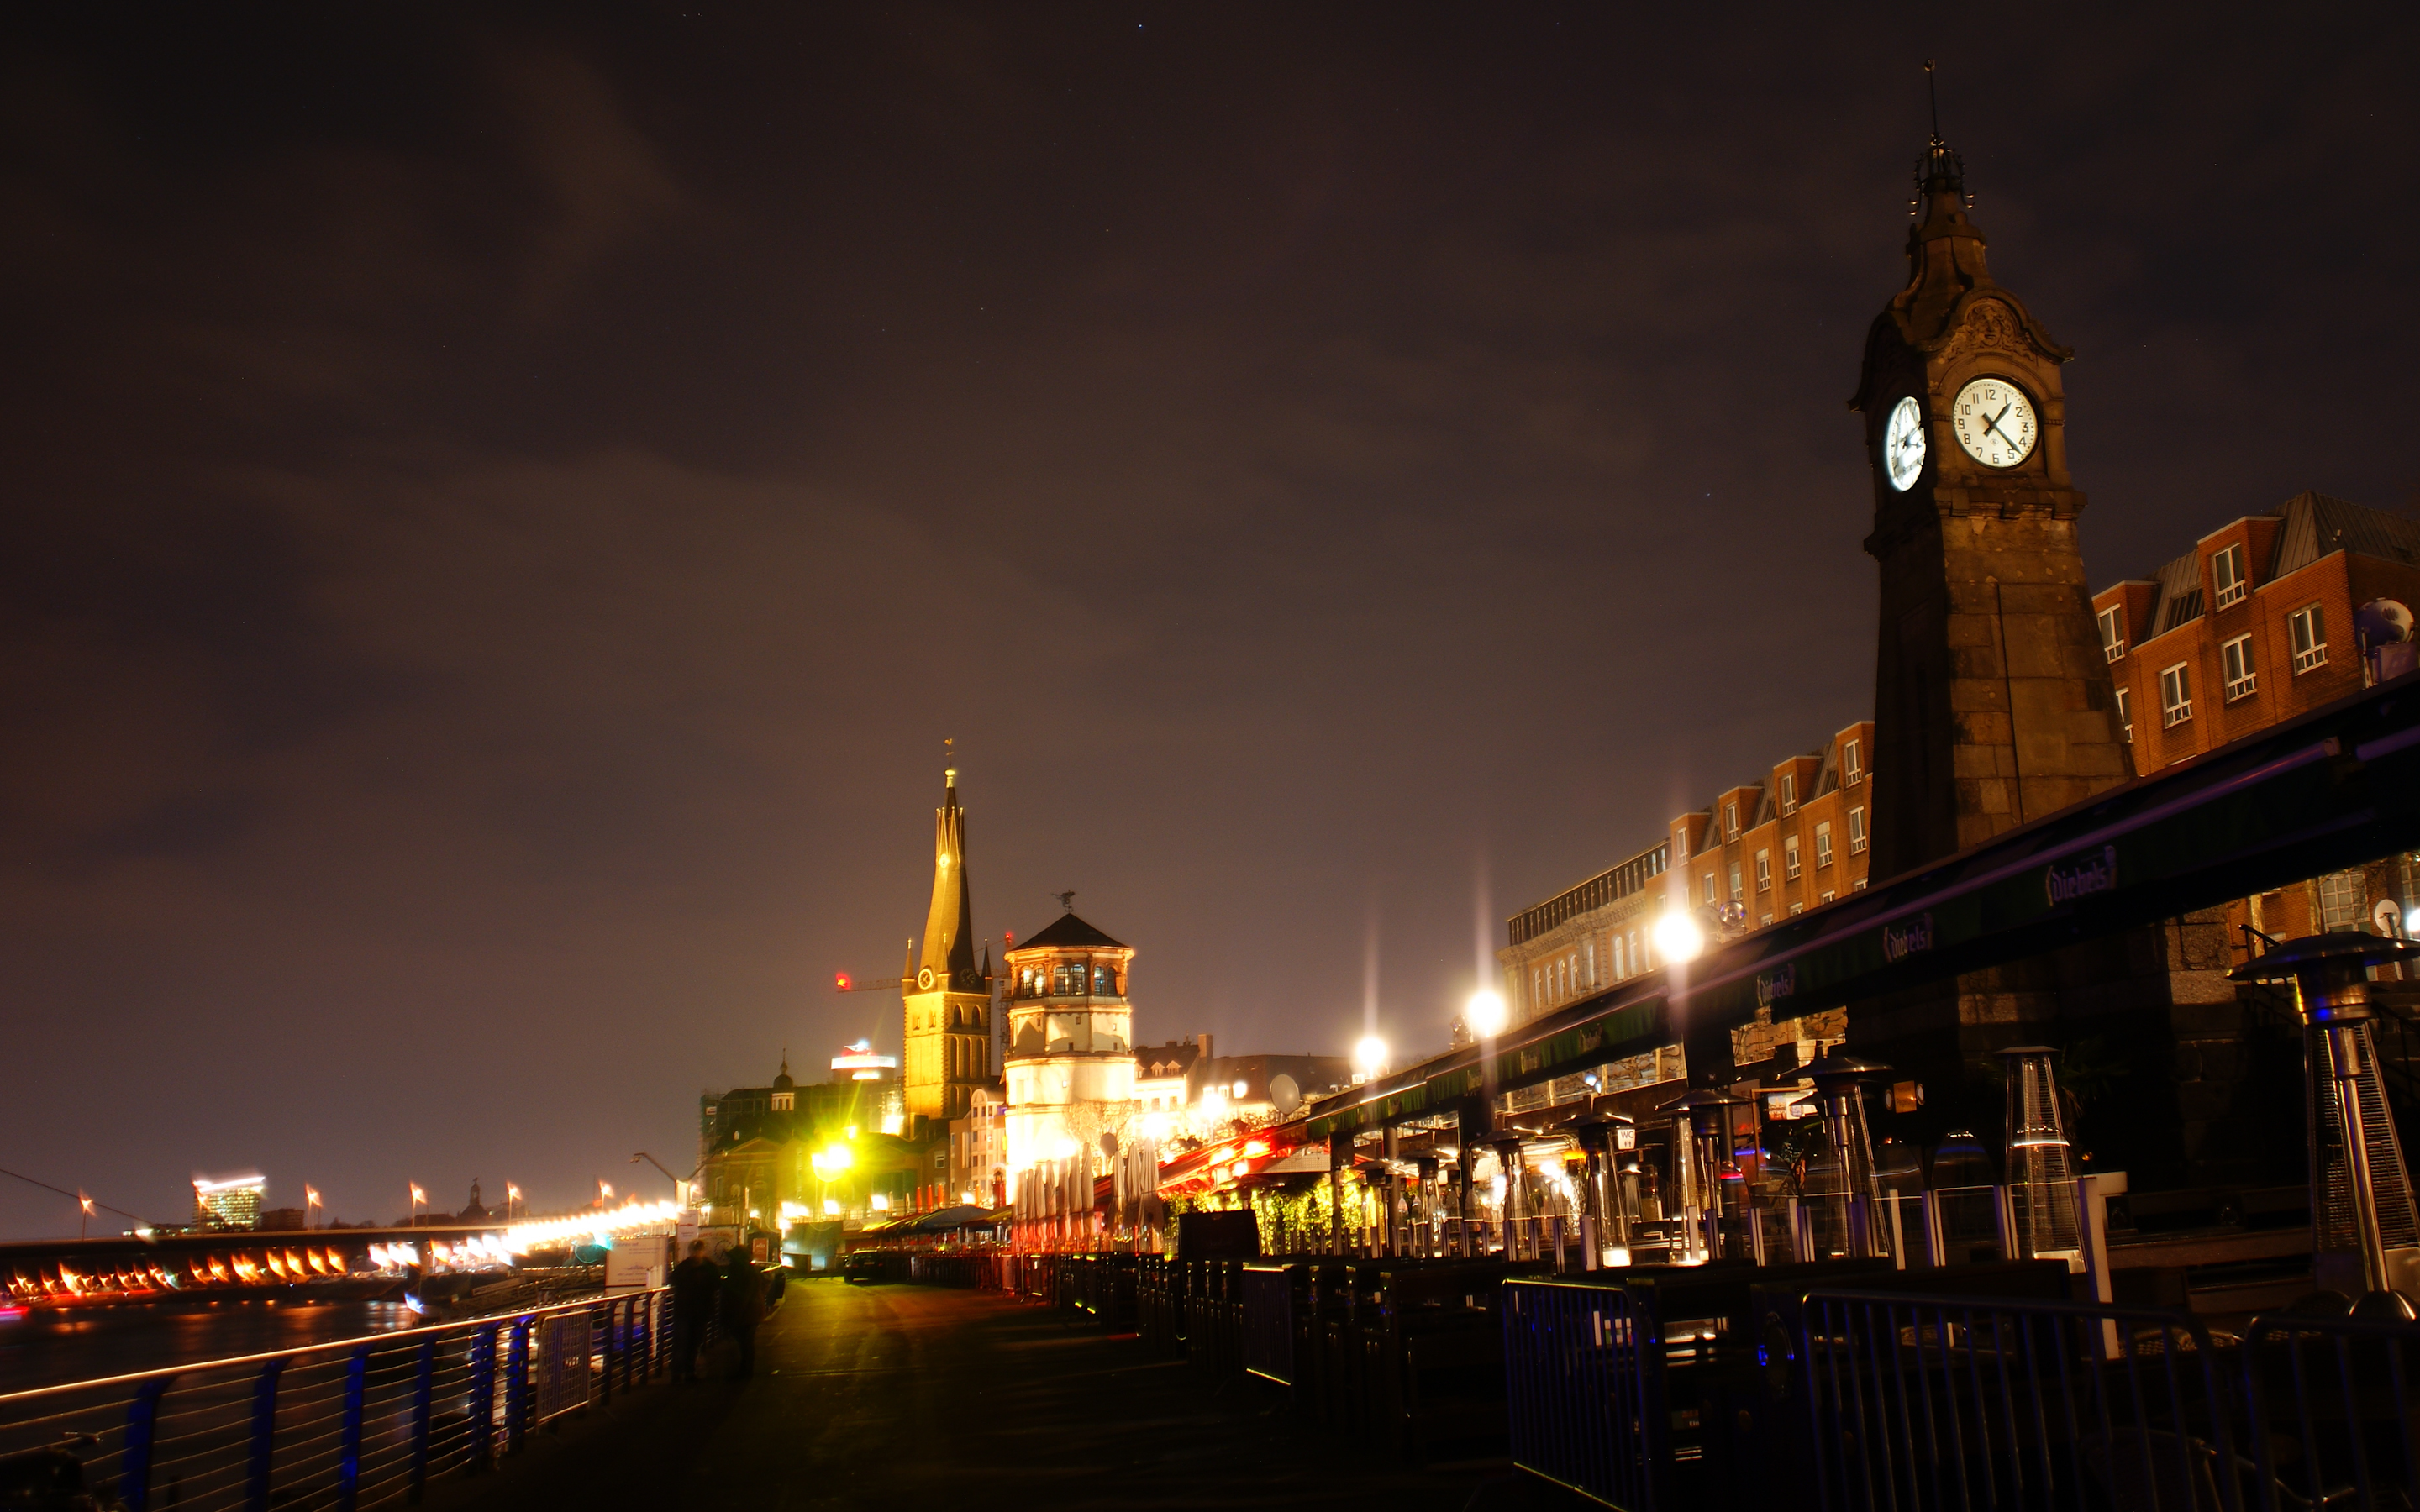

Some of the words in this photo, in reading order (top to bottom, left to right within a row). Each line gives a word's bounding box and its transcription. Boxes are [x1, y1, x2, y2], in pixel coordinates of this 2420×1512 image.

[1973, 394, 1979, 404] 11
[1986, 389, 1996, 400] 12
[1961, 404, 1971, 415] 10
[2016, 407, 2023, 417] 2
[1958, 418, 1965, 429] 9
[2022, 422, 2028, 433] 3
[1964, 433, 1970, 444] 8
[2019, 436, 2027, 447] 4
[1976, 447, 1983, 458] 7
[2007, 449, 2014, 459] 5
[1992, 454, 1999, 464] 6
[1620, 1131, 1634, 1139] WC
